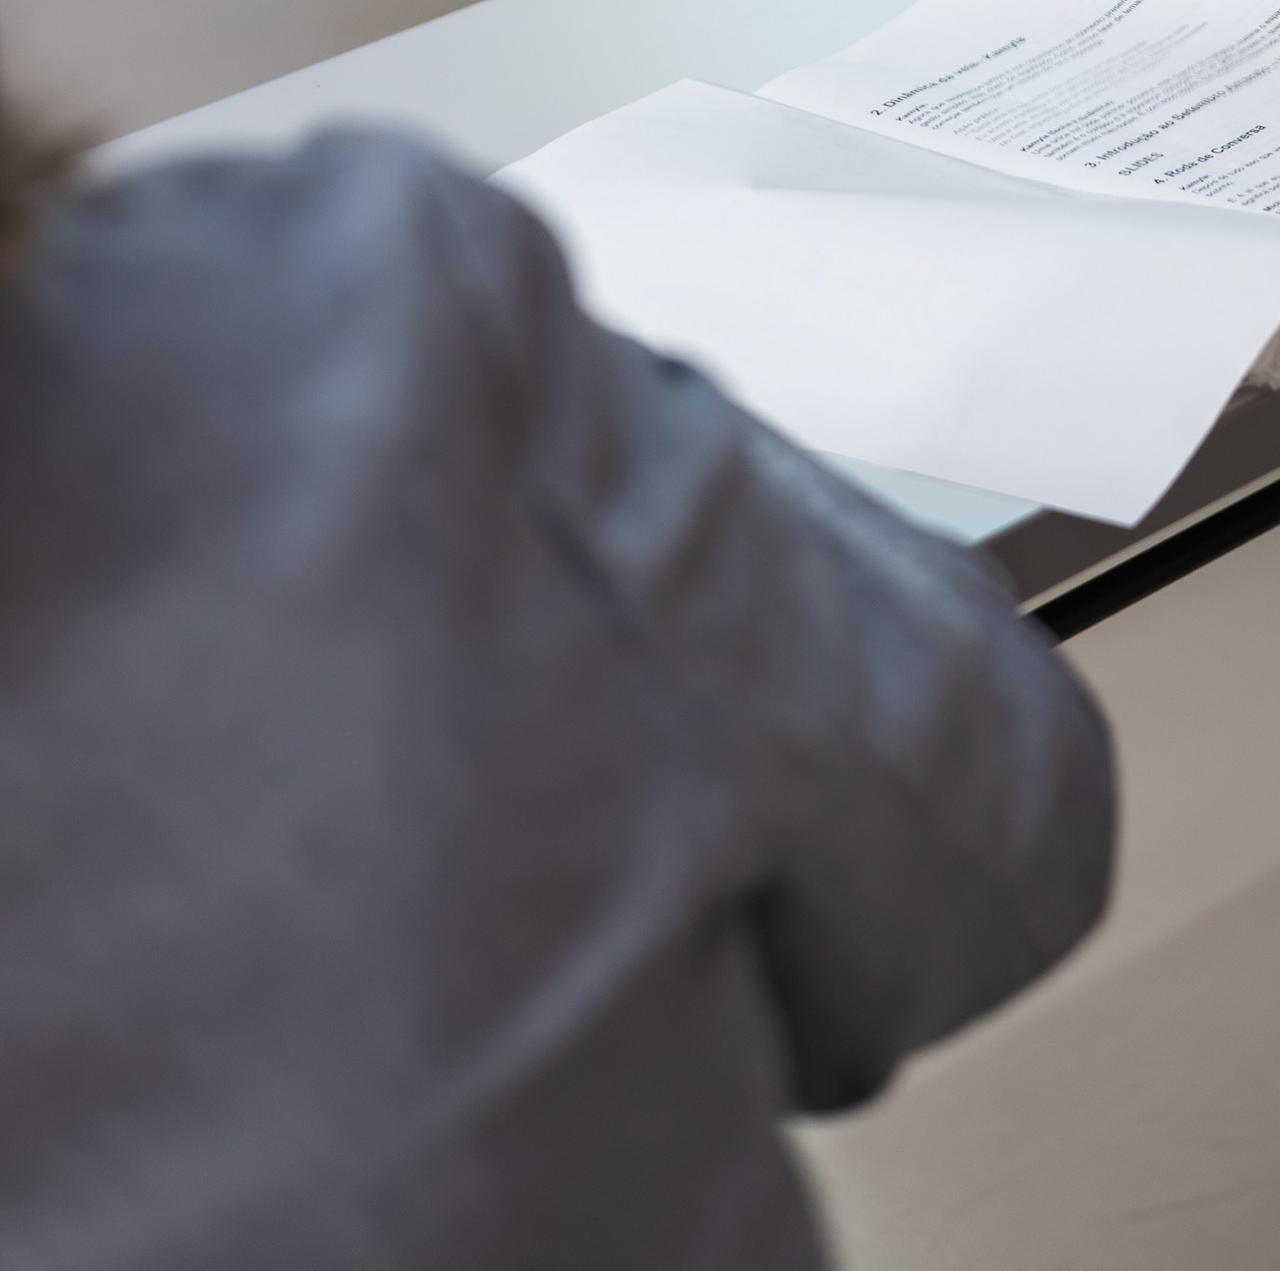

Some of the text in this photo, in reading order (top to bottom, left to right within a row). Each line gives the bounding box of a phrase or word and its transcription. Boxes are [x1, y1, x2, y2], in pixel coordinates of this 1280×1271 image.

[870, 108, 885, 117] 2.
[882, 82, 938, 108] Dinâmica
[1083, 161, 1101, 169] 3.
[1096, 130, 1159, 160] Introdução
[1158, 121, 1175, 130] ao
[1171, 91, 1226, 120] Setembro
[1118, 153, 1164, 176] SLIDES
[1152, 125, 1266, 186] 4. Roda de Conversa
